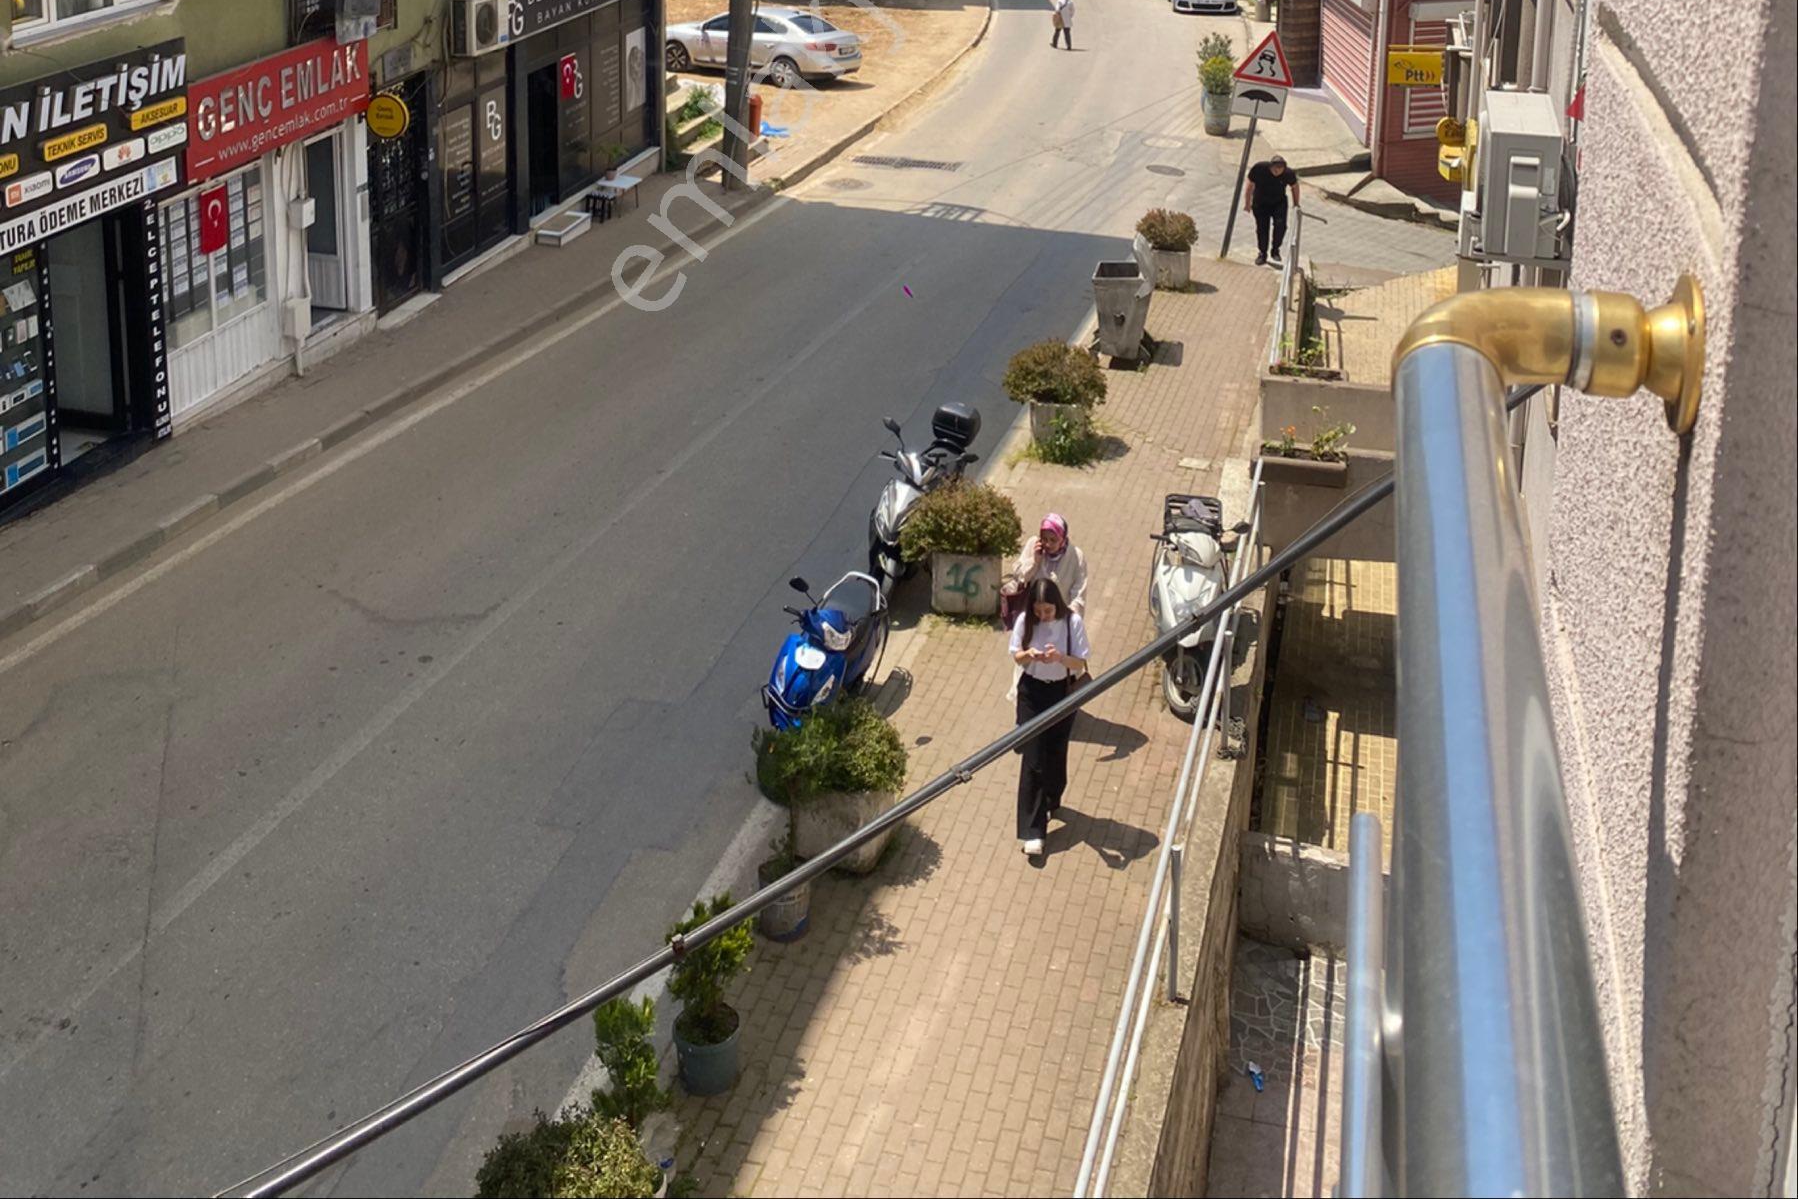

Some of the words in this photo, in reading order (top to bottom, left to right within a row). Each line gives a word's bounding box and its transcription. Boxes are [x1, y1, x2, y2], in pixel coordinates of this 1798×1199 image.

[537, 2, 572, 23] BAYAN
[39, 54, 186, 132] İLETİŞİM
[198, 75, 273, 141] GENÇ
[281, 42, 361, 109] EMLAK
[1405, 69, 1425, 82] Ptt
[141, 103, 178, 124] AKSESUAR
[218, 97, 348, 161] www.gencemlak.com.tr
[47, 138, 76, 158] TEKNİK
[76, 128, 105, 148] SERVİS
[40, 200, 86, 233] ÖDEME
[90, 172, 145, 214] MERKEZİ
[943, 562, 984, 598] 16
